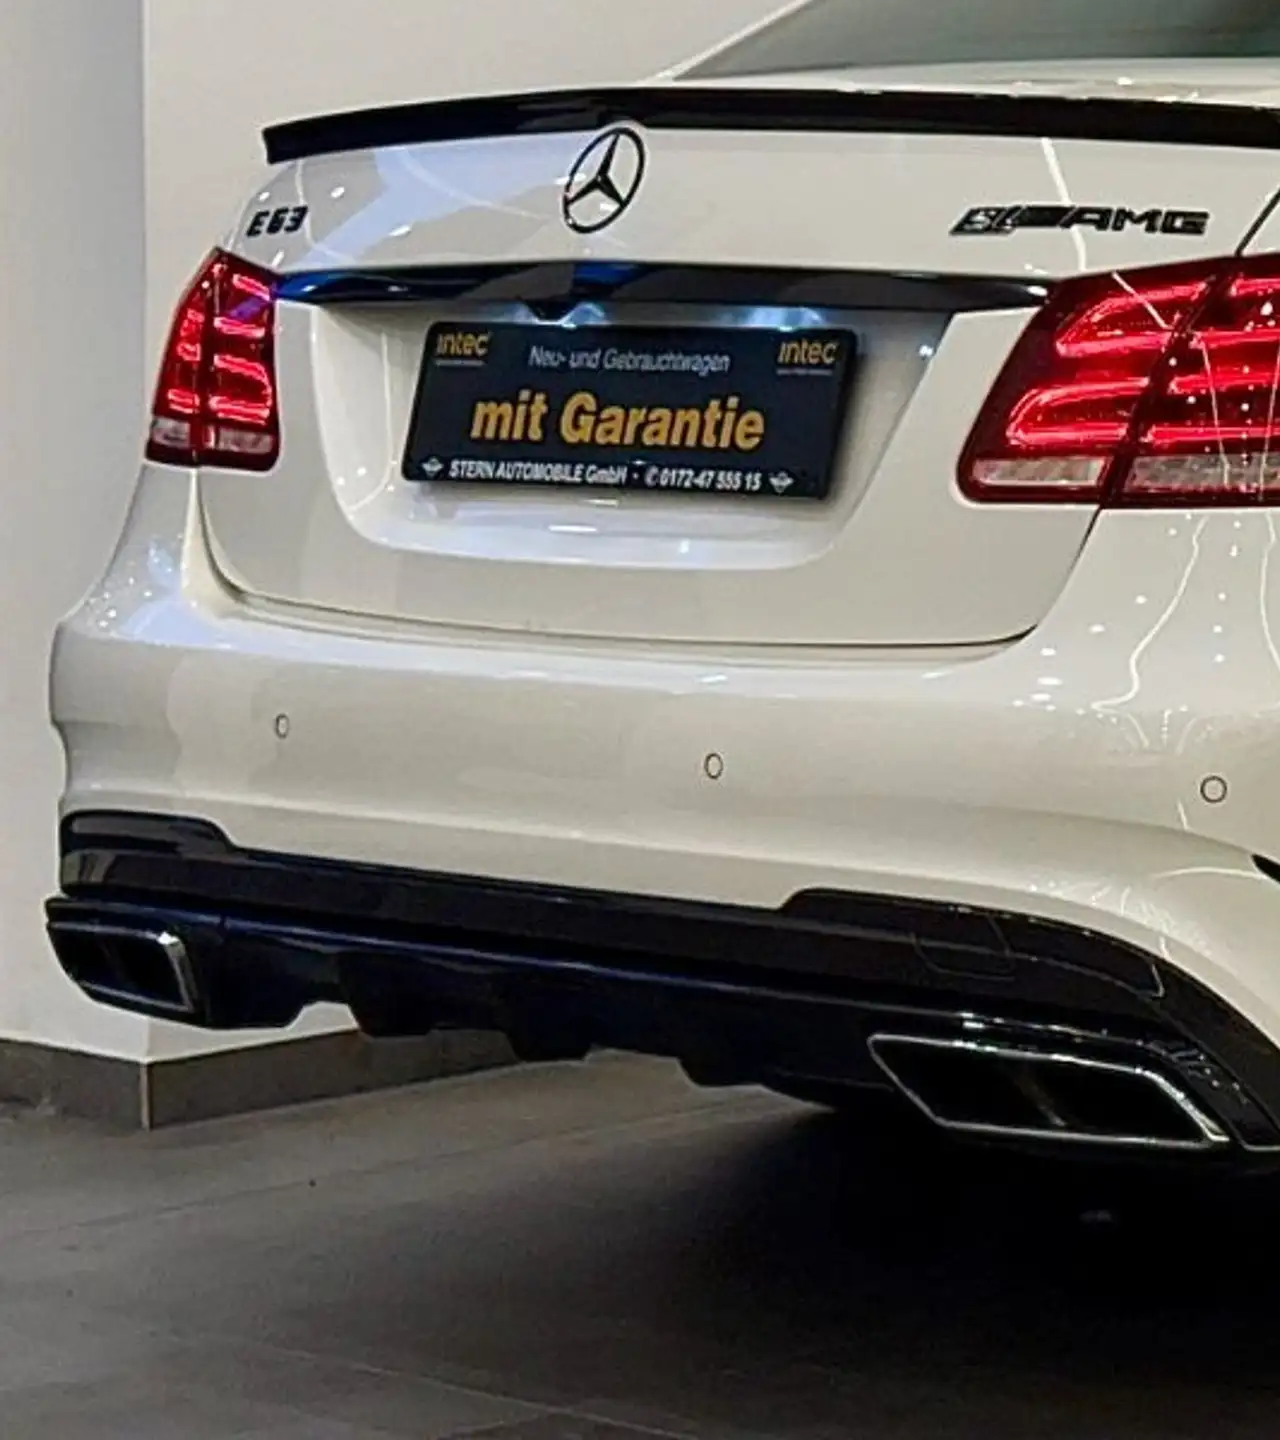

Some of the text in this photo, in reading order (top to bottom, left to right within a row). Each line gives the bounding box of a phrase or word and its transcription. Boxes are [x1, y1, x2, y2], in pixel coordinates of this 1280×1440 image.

[245, 205, 308, 237] E63
[1060, 206, 1210, 235] AMG
[436, 332, 490, 356] intec
[777, 340, 838, 365] intec
[568, 349, 601, 369] und
[603, 348, 731, 377] Gebrauchtwagen
[470, 389, 766, 450] mit Garantie
[449, 460, 495, 479] STERN
[494, 462, 584, 481] AUTOMOBILE
[585, 464, 628, 485] GmbH
